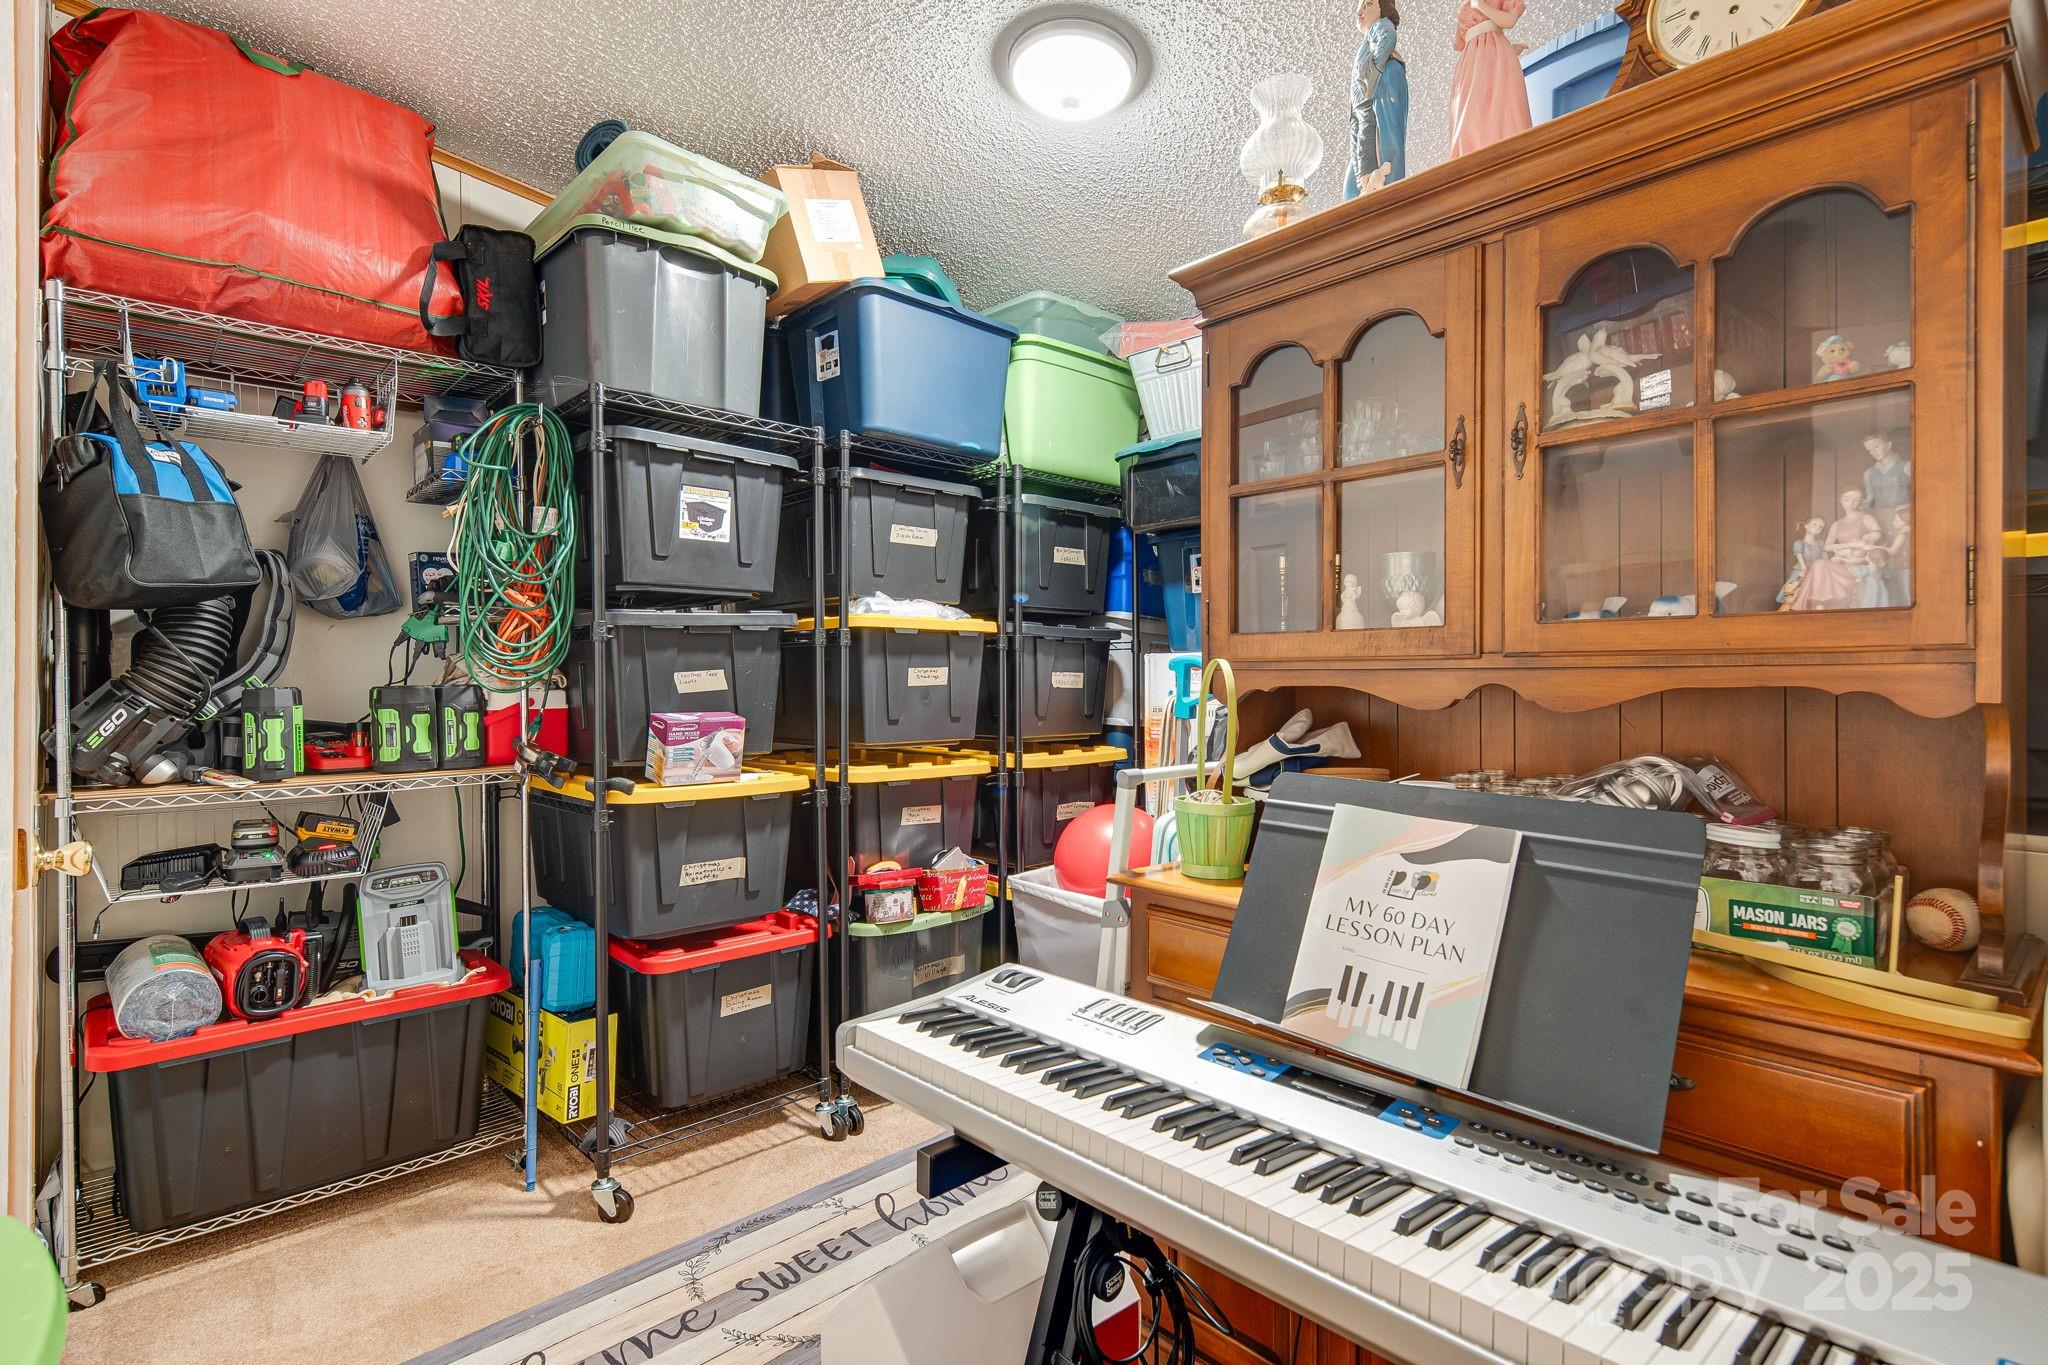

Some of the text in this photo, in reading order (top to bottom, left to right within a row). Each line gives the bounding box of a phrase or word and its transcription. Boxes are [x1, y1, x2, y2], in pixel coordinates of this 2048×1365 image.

[86, 708, 128, 749] EGO
[1344, 896, 1456, 936] MY 60 DAY
[1732, 904, 1829, 932] MASON JARS
[1325, 914, 1466, 963] LESSON PLAN
[959, 994, 1011, 1014] ALESIS
[568, 1085, 579, 1119] RYOBI
[735, 1226, 872, 1303] SWEET
